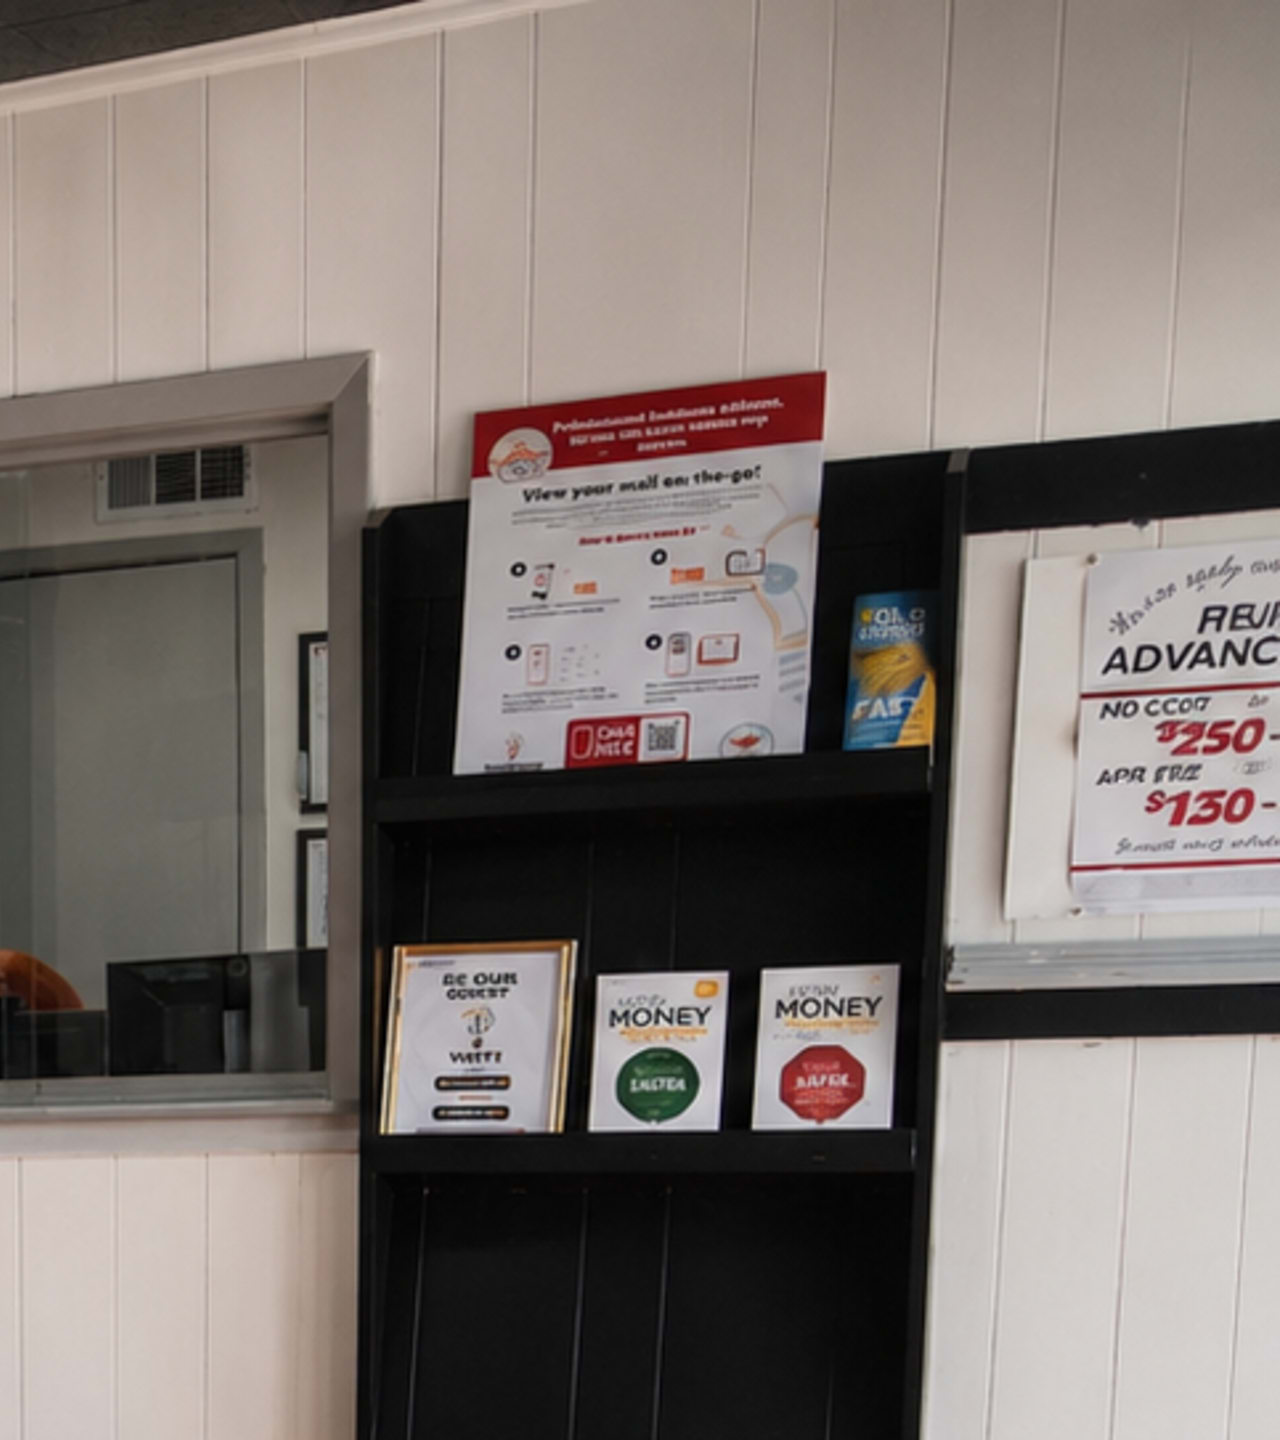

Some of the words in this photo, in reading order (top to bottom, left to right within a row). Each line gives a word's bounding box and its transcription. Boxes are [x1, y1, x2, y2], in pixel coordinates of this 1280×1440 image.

[1099, 699, 1140, 720] NO
[609, 1005, 713, 1028] MONEY
[775, 995, 884, 1019] MONEY
